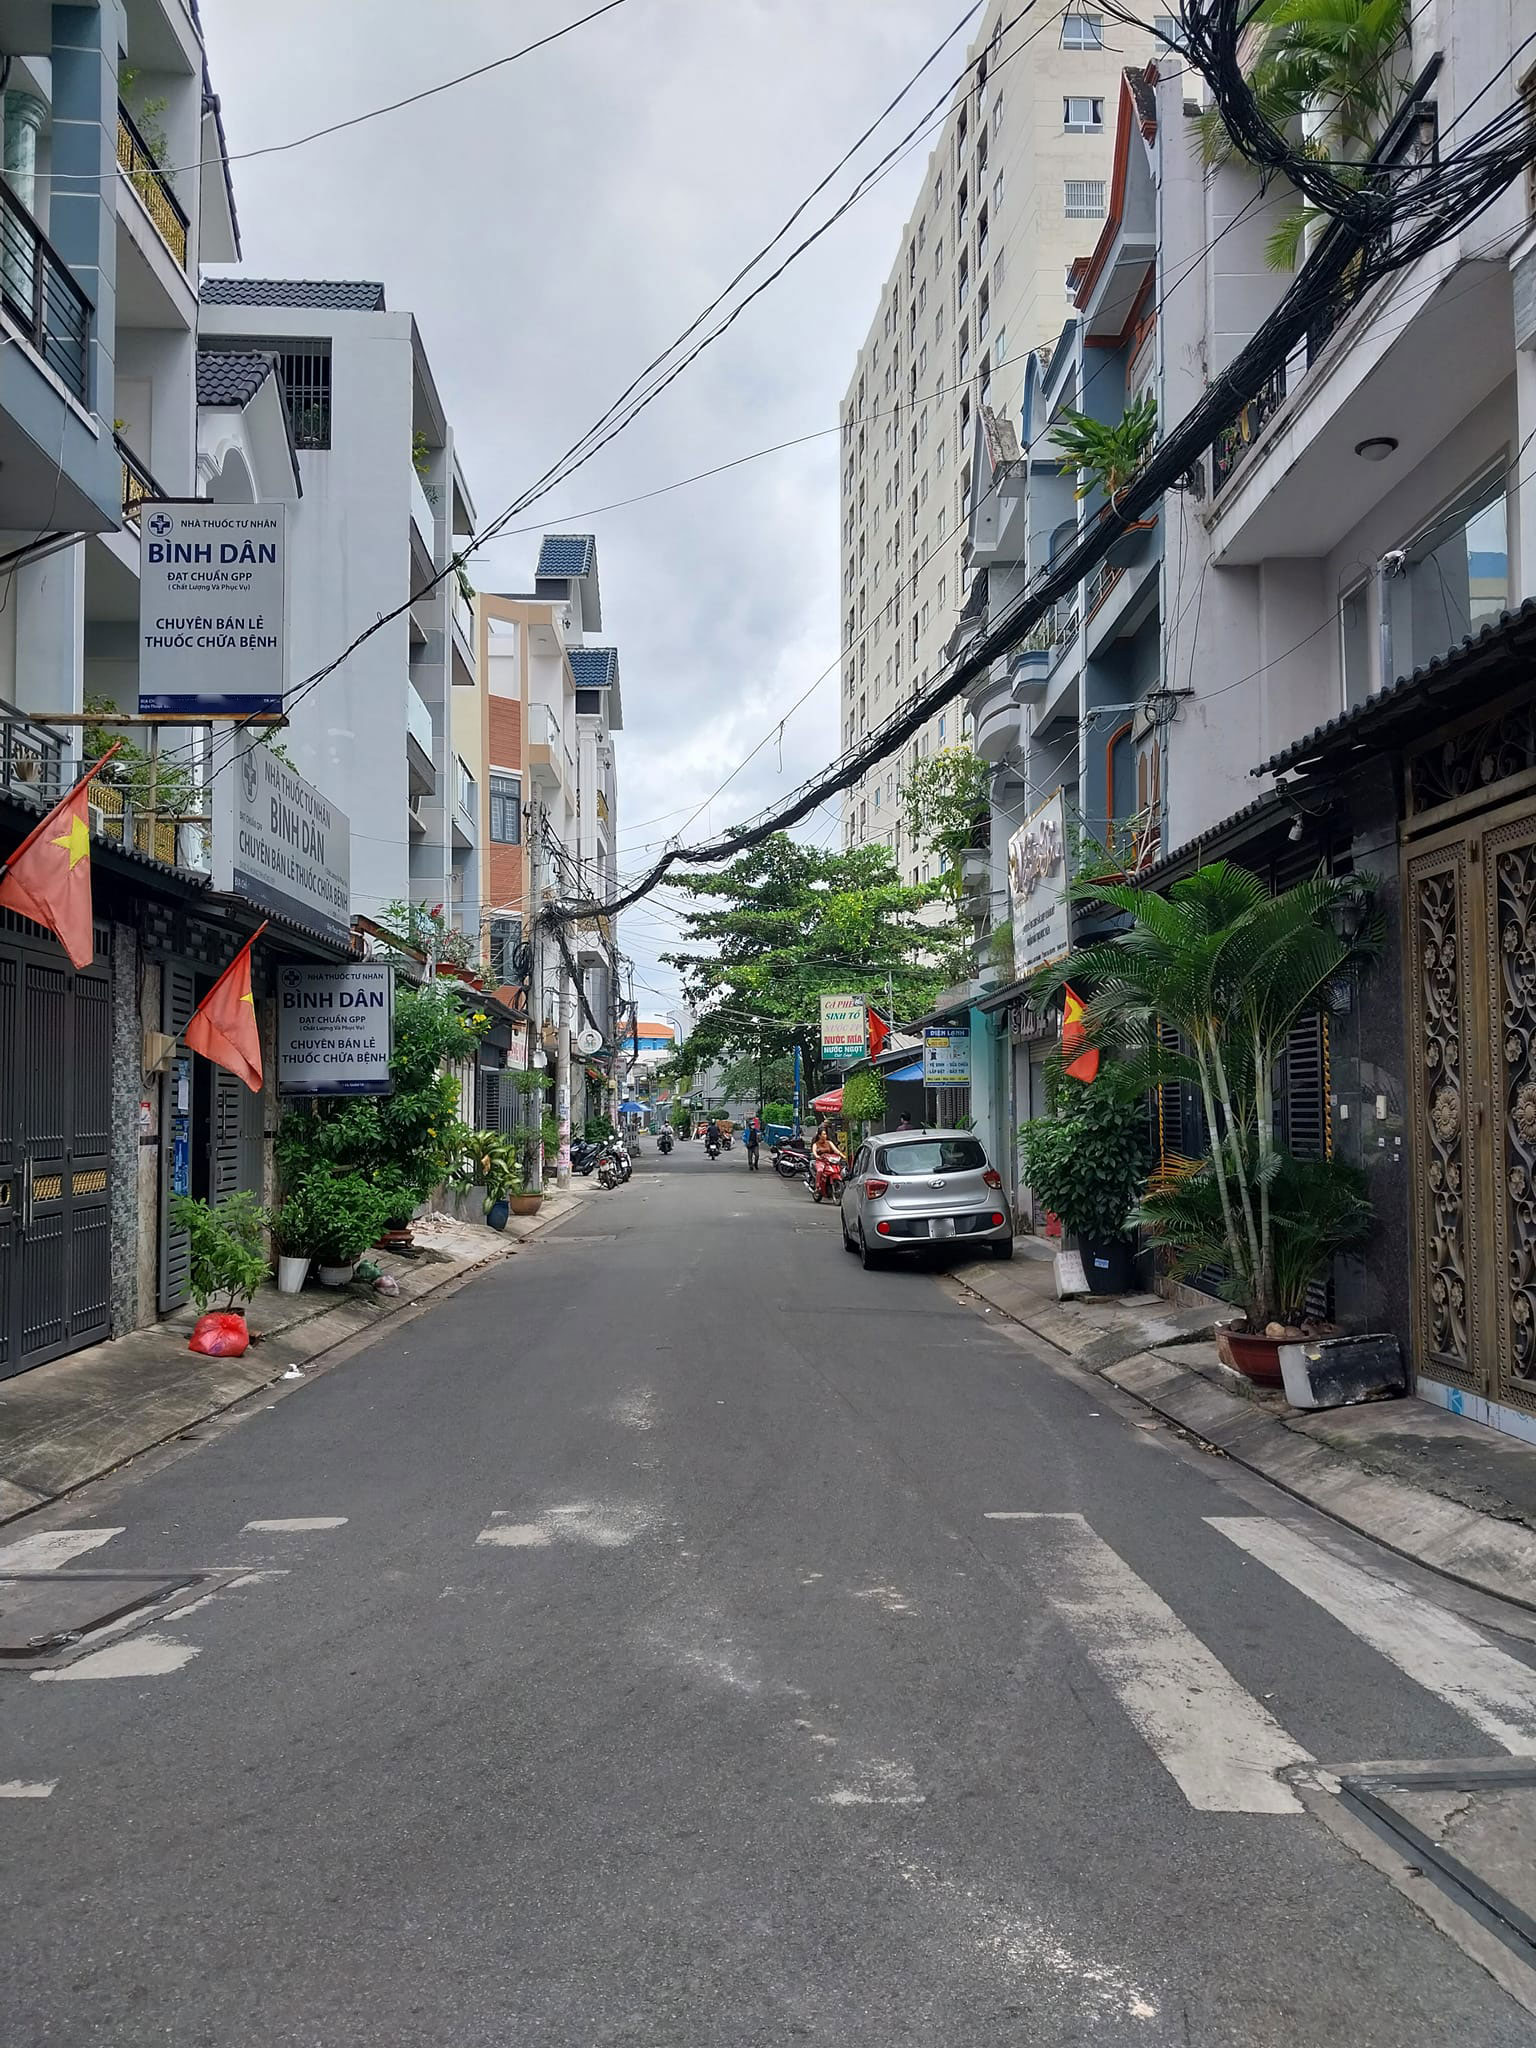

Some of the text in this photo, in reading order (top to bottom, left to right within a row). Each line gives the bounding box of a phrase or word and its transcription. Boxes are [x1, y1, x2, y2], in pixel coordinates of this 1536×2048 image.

[180, 517, 277, 529] NHÀ THUỐC TƯ NHÂN
[148, 539, 276, 564] BÌNH DÂN
[167, 572, 189, 584] ĐẠT
[231, 572, 253, 582] GPP
[156, 614, 264, 630] CHUYÊN BÁN LẺ
[144, 633, 277, 650] THUỐC CHỮA BỆNH
[264, 761, 331, 830] NHÀ THUỐC TƯ NHÂN
[270, 793, 325, 866] BÌNH DÂN
[239, 830, 270, 868] CHUYÊN
[271, 847, 286, 876] BÁN
[287, 855, 295, 881] LẺ
[295, 863, 317, 894] THUỐC
[317, 877, 333, 904] CHỮA
[333, 886, 348, 913] BỆNH
[325, 971, 350, 980] THUỐC
[363, 972, 384, 980] NHÂN
[283, 988, 384, 1009] BÌNH DÂN
[349, 1015, 366, 1023] GPP
[825, 1012, 847, 1020] SINH
[290, 1036, 376, 1050] CHUYÊN BÁN LẺ
[282, 1052, 386, 1065] THUỐC CHỮA BỆNH
